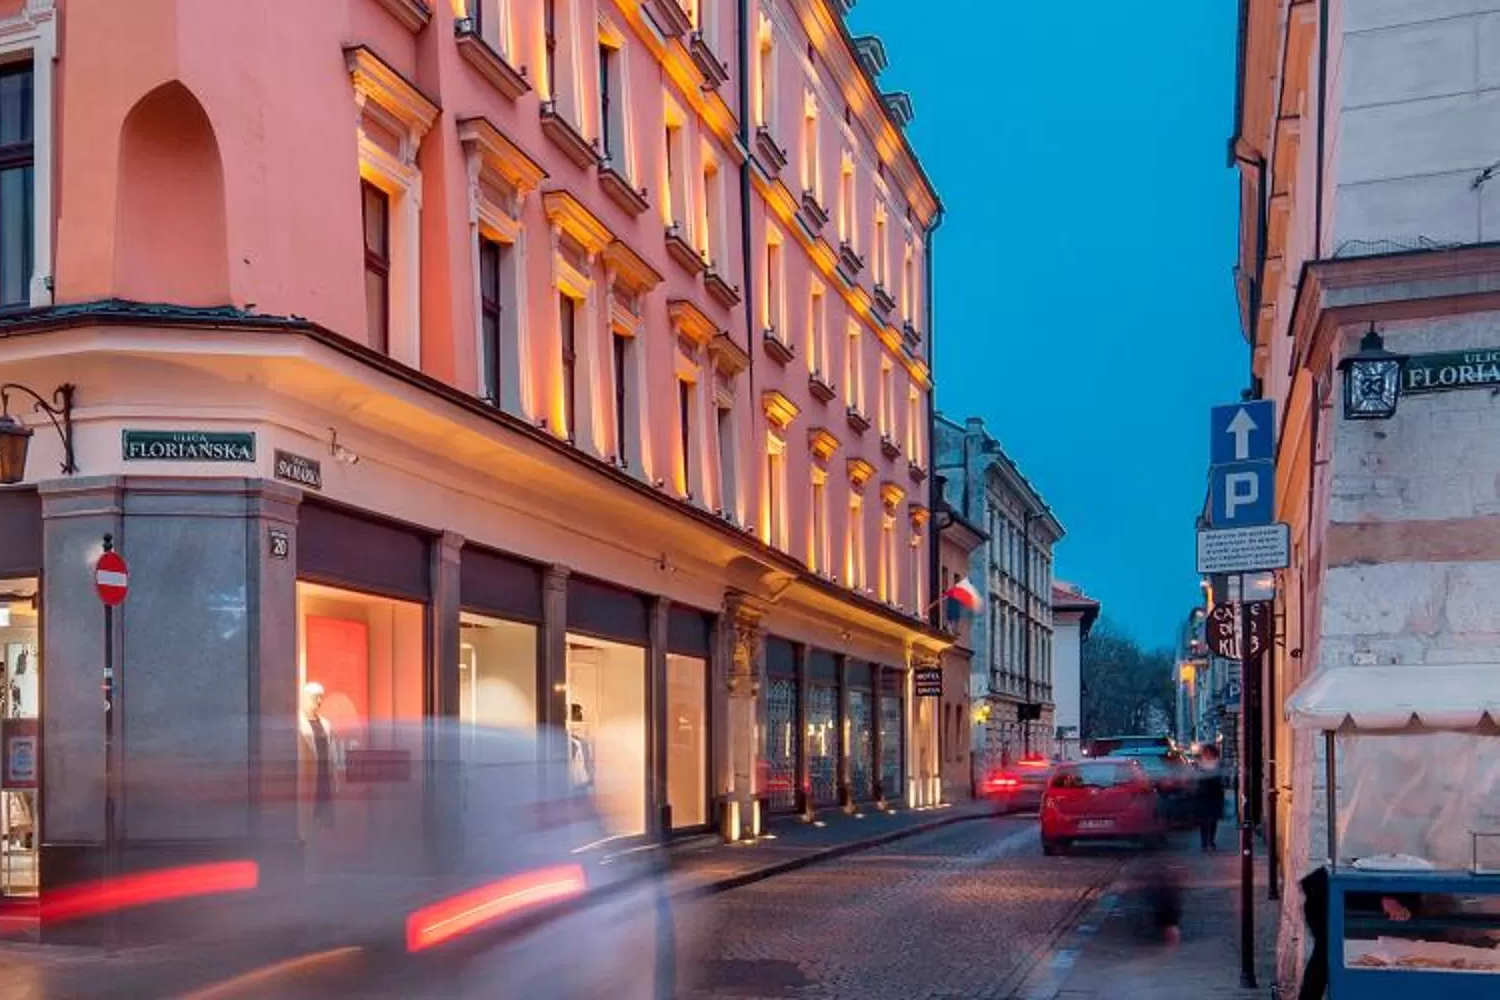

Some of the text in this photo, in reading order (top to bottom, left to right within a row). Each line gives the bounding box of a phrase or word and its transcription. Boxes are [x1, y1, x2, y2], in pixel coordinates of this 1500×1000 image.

[173, 432, 208, 442] ULICA
[129, 440, 251, 459] FLORIAŃSKA
[1226, 471, 1259, 518] P
